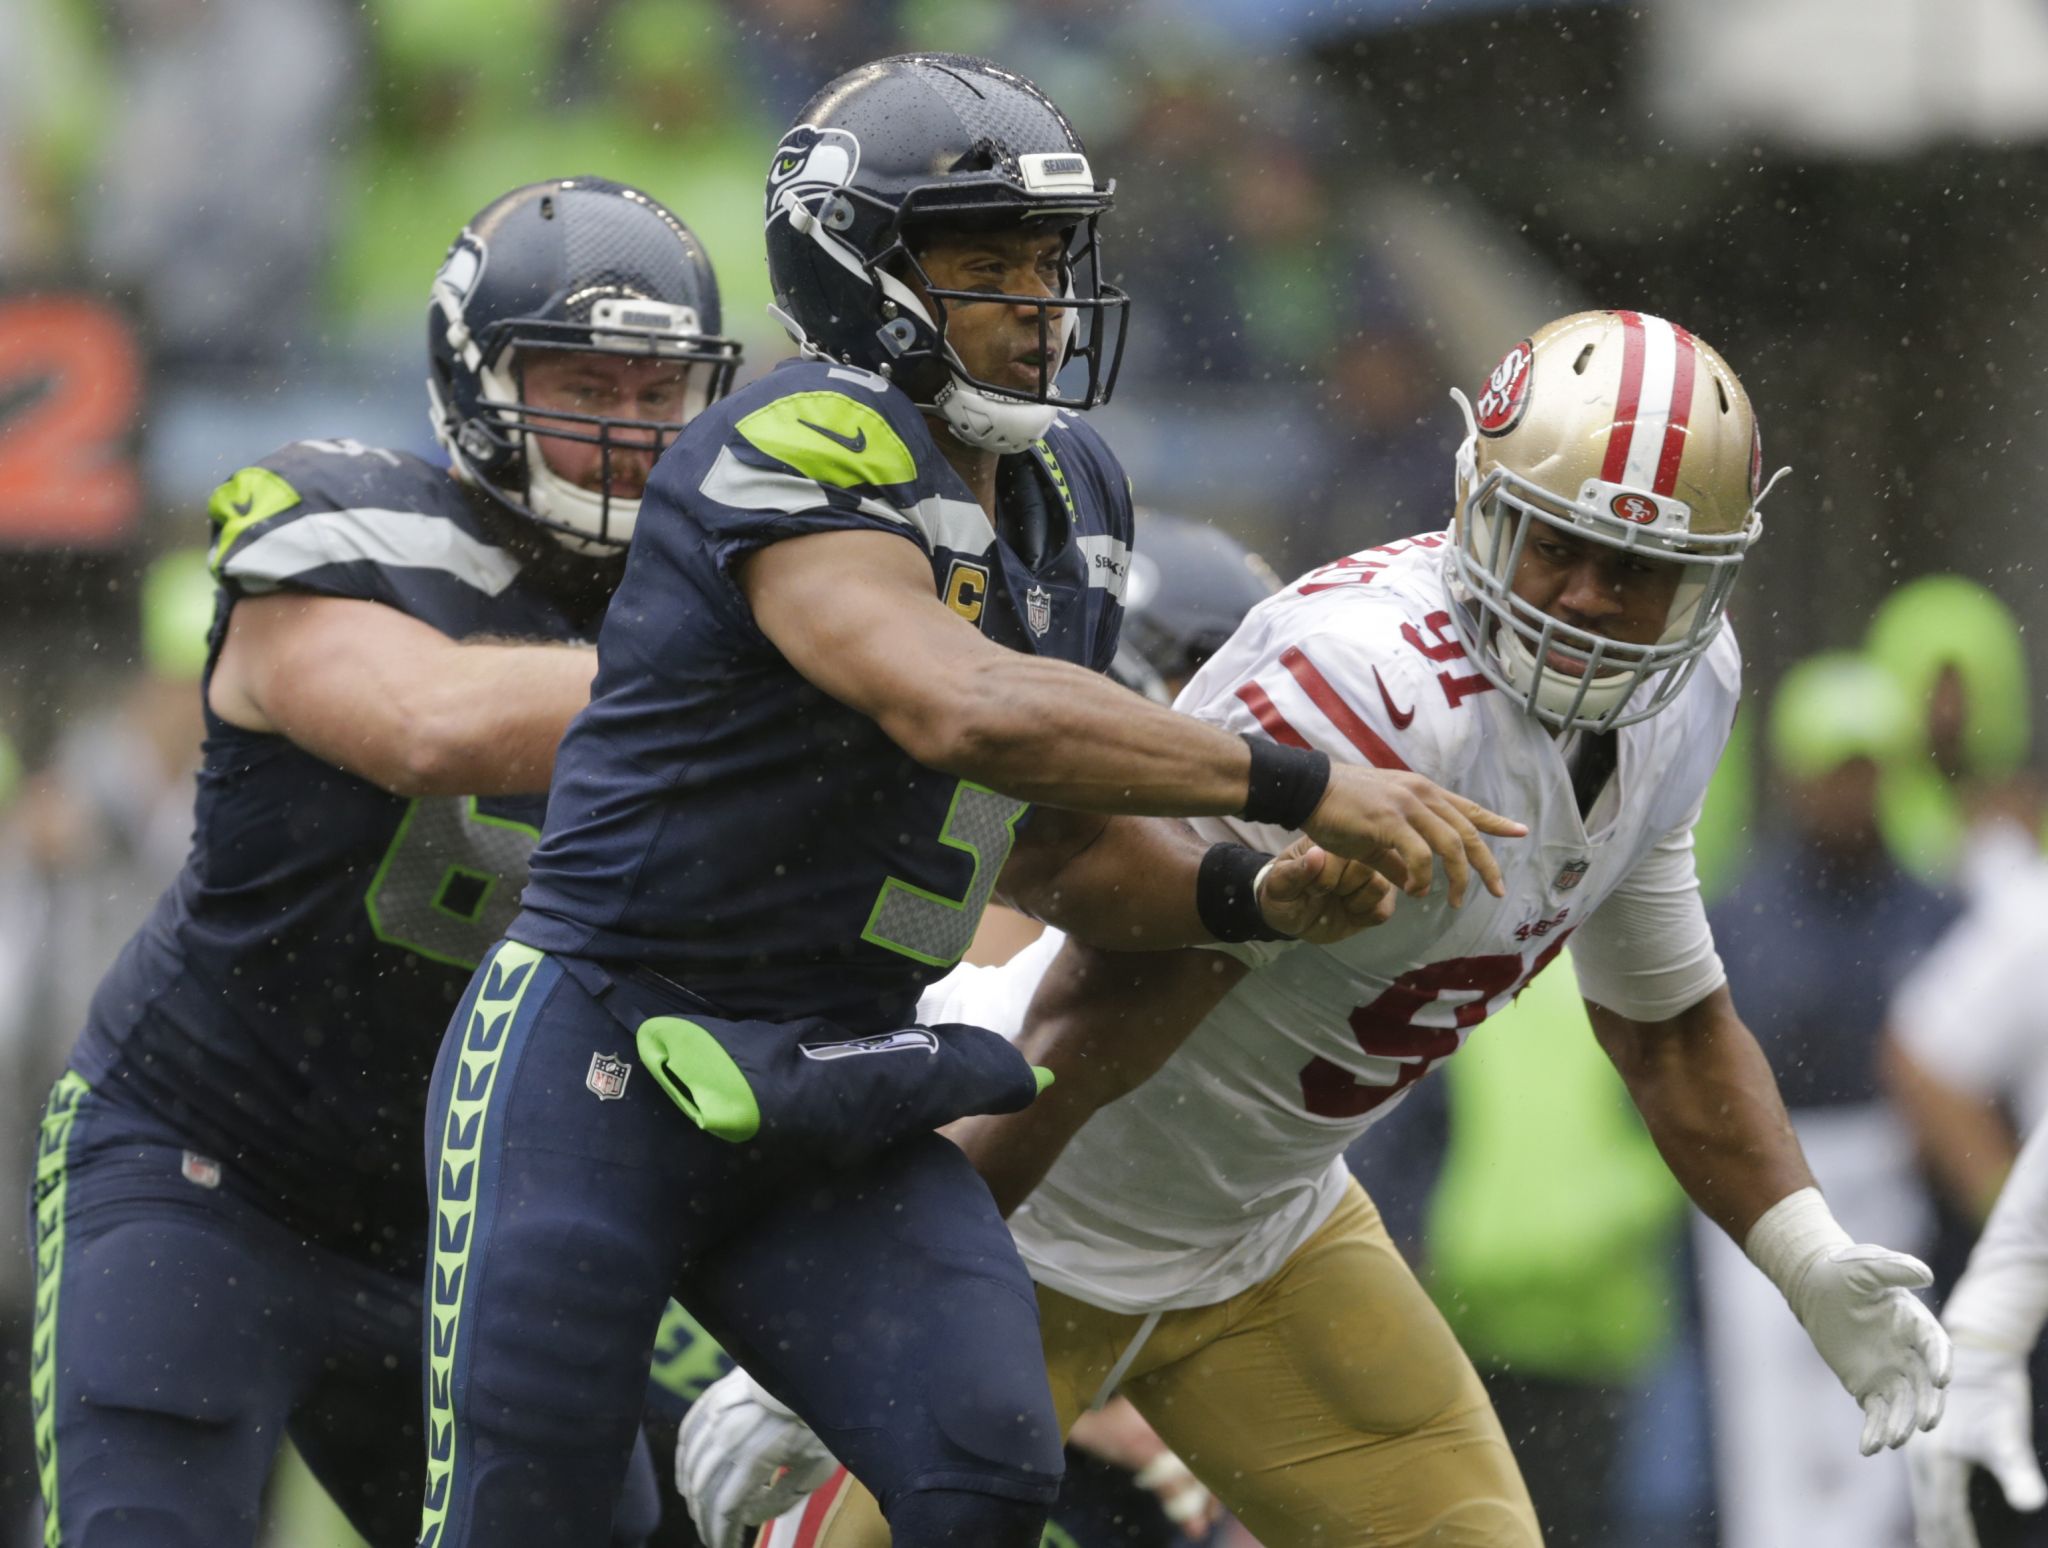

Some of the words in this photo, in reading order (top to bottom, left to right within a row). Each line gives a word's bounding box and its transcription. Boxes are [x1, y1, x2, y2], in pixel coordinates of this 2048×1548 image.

[946, 566, 985, 622] C
[860, 778, 1031, 969] 3
[593, 1070, 622, 1095] NFL
